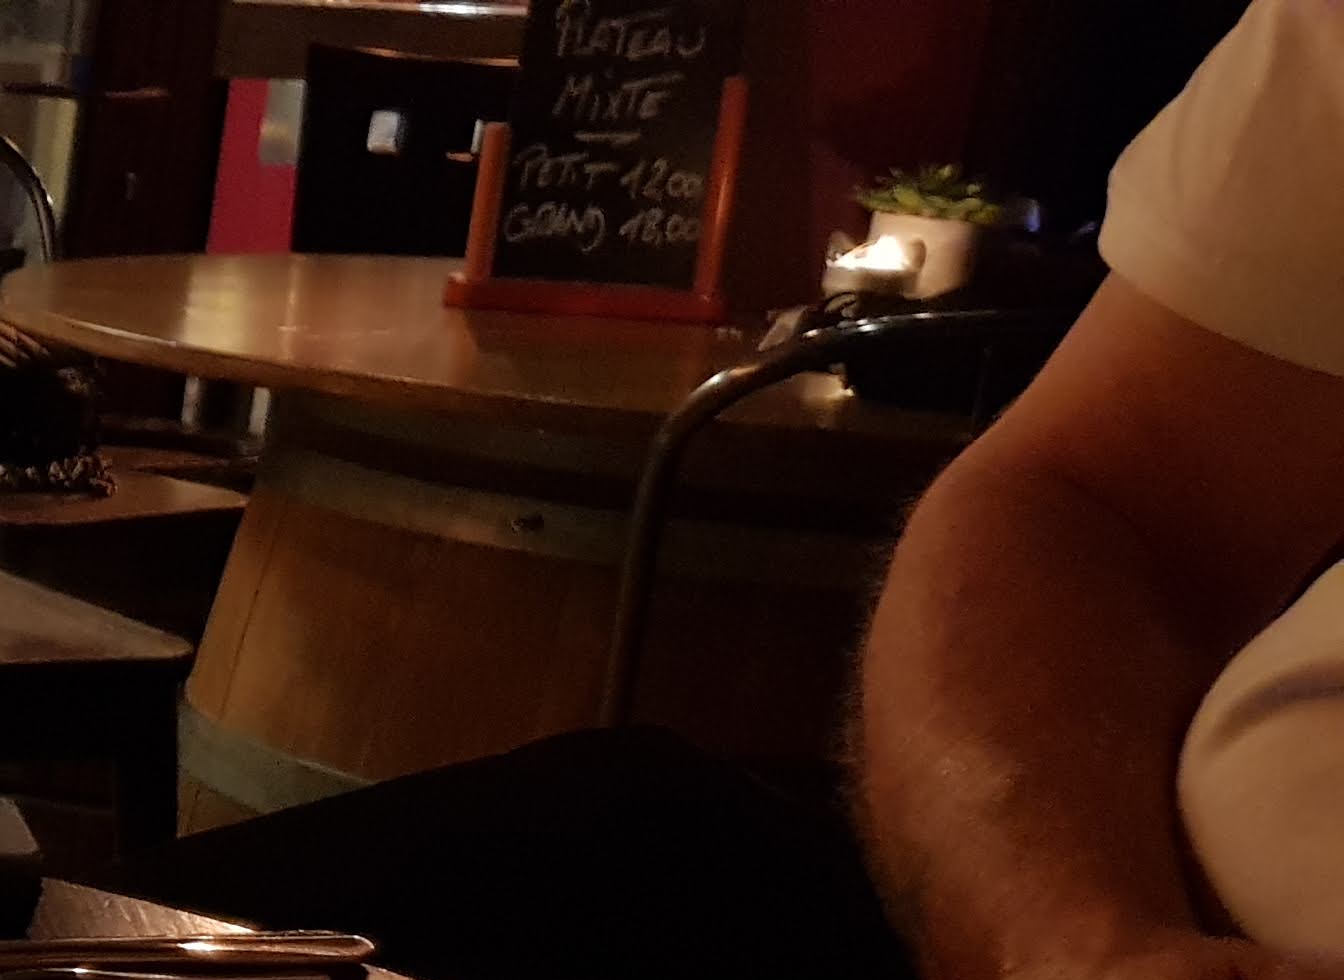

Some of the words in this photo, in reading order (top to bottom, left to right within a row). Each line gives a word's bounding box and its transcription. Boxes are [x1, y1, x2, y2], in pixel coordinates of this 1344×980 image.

[554, 1, 706, 61] PLATEAU
[551, 68, 686, 121] MIXTE
[514, 143, 619, 191] PETIT
[504, 201, 606, 254] GRAND
